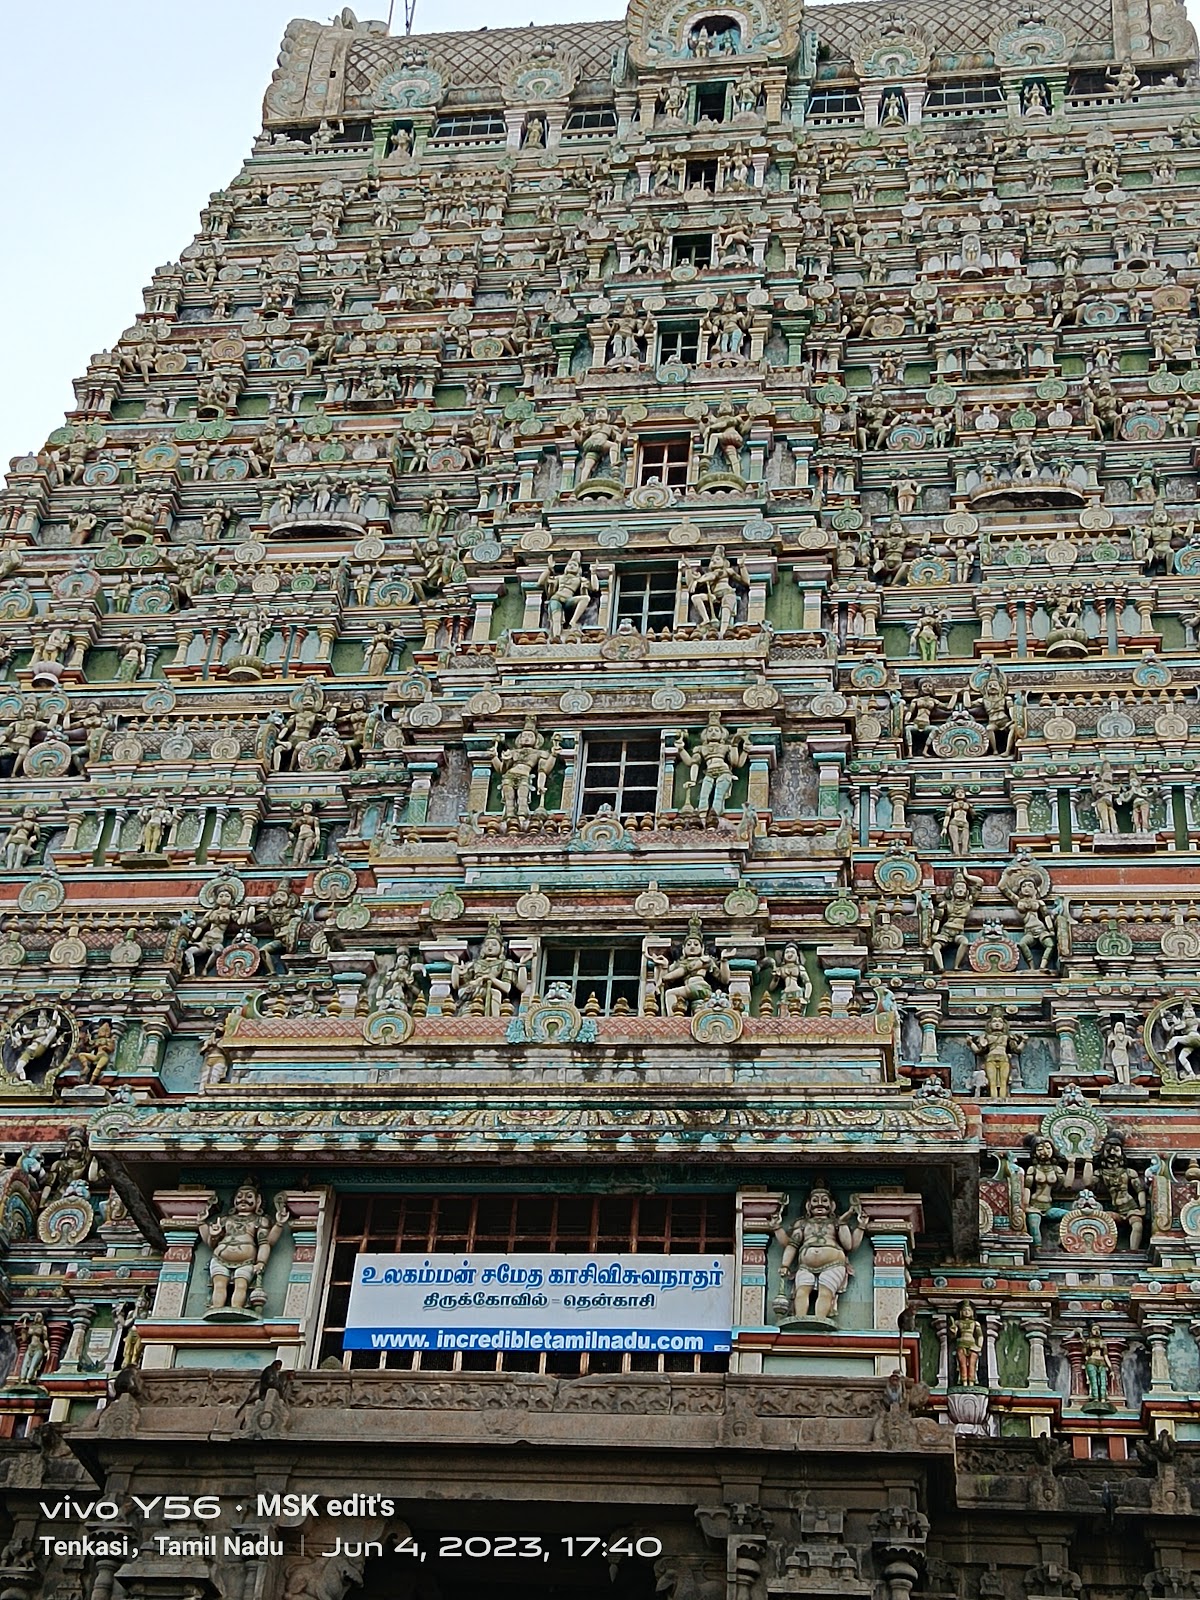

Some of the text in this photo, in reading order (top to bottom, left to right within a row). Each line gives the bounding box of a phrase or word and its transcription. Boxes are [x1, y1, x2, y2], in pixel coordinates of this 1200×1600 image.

[361, 1259, 724, 1291] உலகம்மன் சமேத காசிவிசுவநாதர்
[423, 1291, 549, 1310] திருக்கோவில்
[563, 1293, 656, 1310] தென்காசி
[371, 1330, 704, 1350] www. incredibletamilnadu.com
